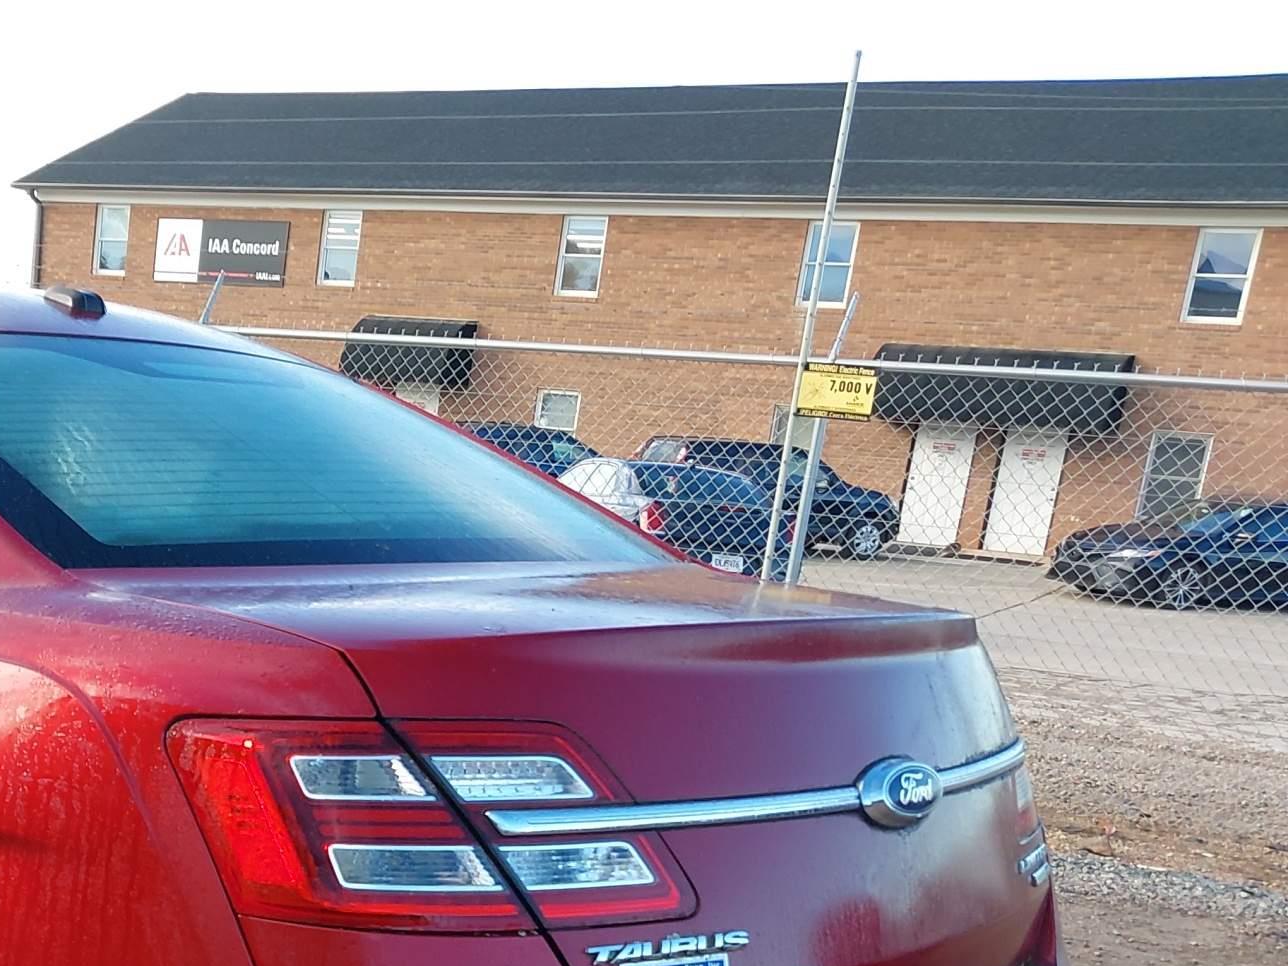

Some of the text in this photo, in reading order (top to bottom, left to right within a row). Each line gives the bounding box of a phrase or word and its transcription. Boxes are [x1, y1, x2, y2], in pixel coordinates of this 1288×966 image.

[208, 238, 280, 256] IAA Concord
[830, 380, 872, 394] 7,000 V
[900, 773, 932, 805] Ford
[586, 931, 750, 964] TAURUS
